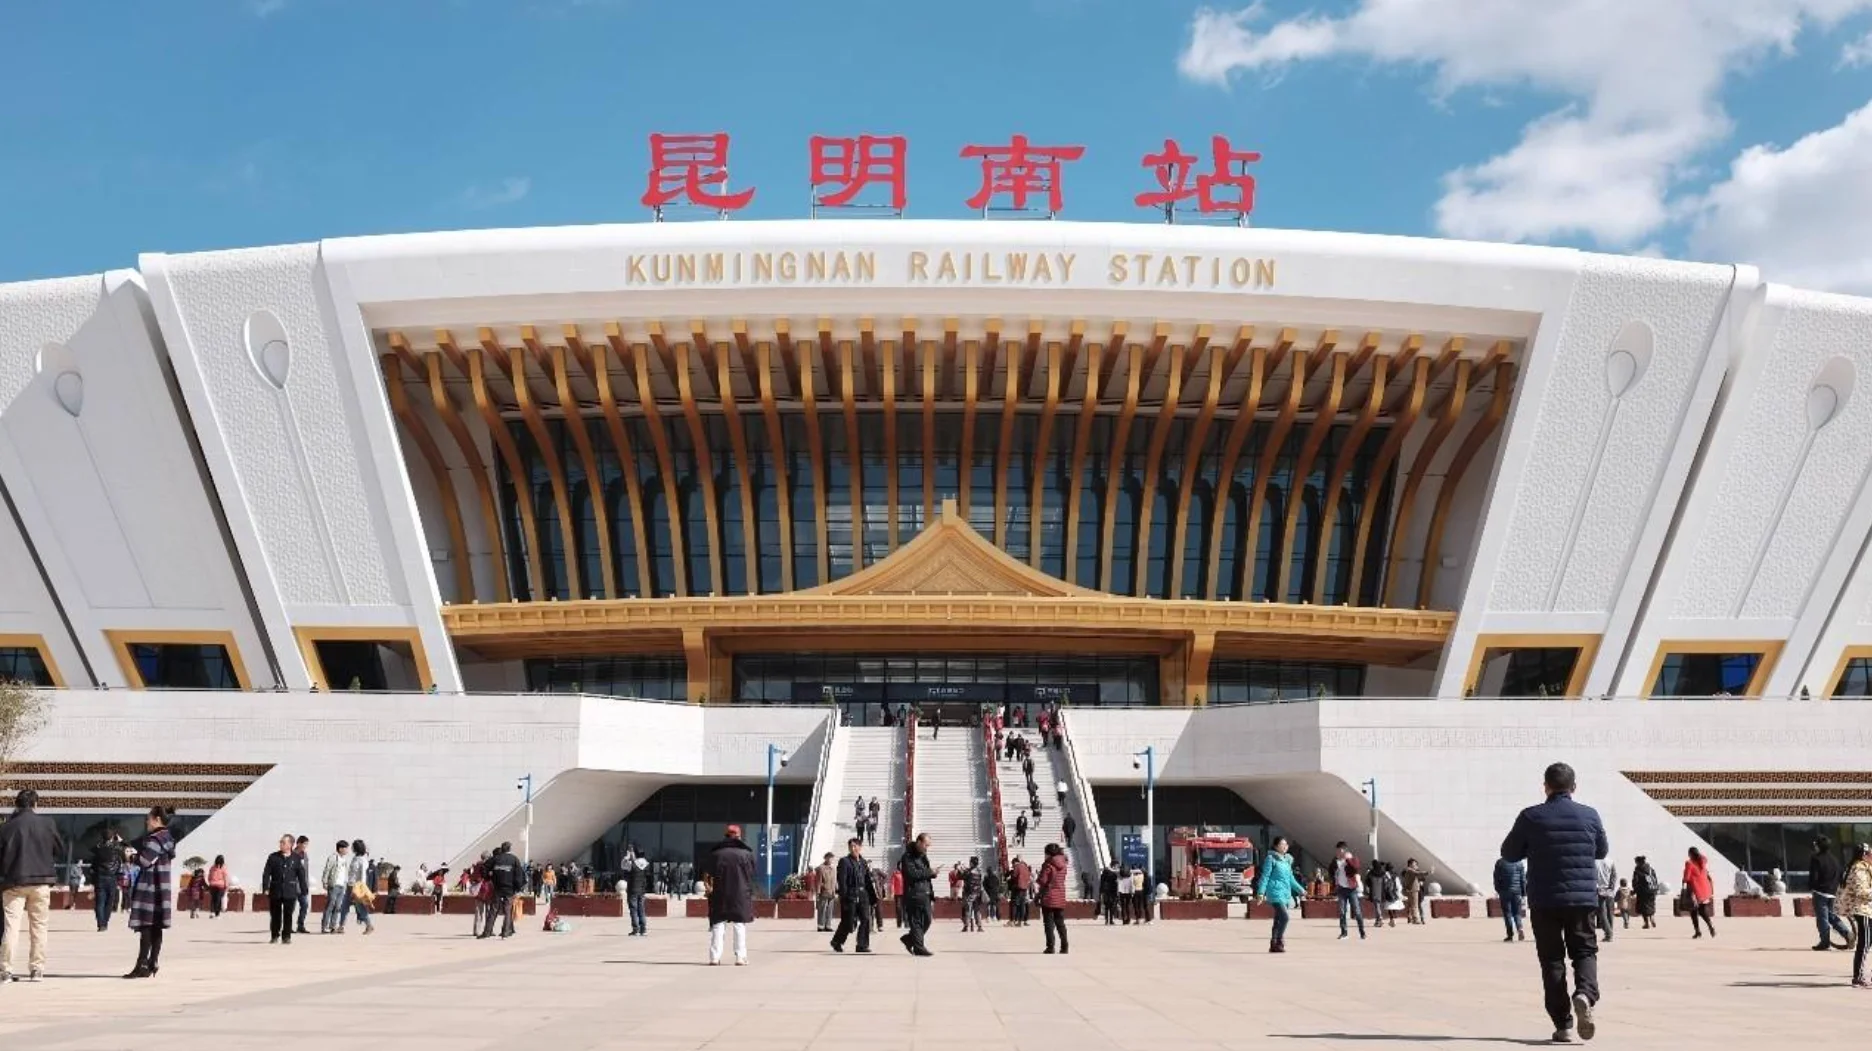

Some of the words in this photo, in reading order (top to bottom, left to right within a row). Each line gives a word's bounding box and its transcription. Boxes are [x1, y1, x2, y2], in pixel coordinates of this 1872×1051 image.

[641, 133, 1261, 212] 昆明南站
[625, 251, 876, 283] KUNMINGNAN
[909, 251, 1076, 282] RAILWAY
[1108, 253, 1276, 288] STATION
